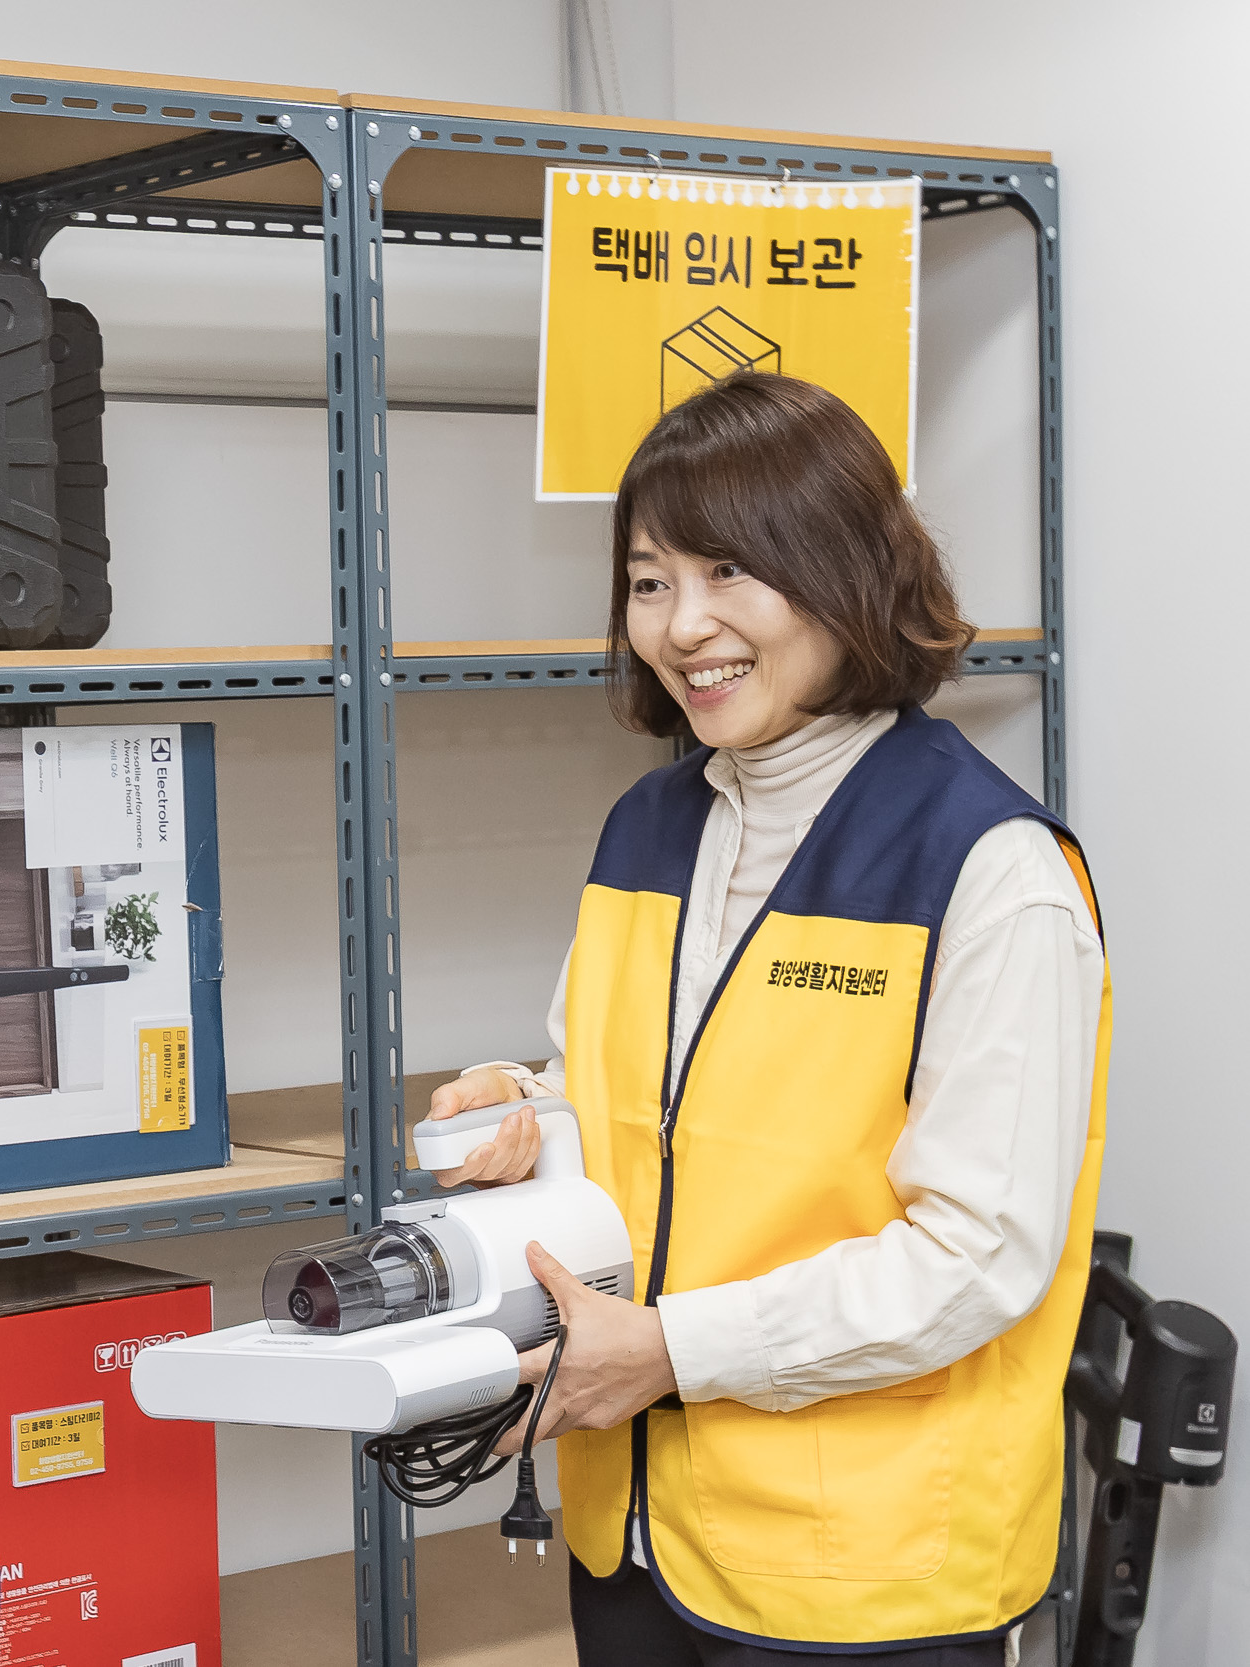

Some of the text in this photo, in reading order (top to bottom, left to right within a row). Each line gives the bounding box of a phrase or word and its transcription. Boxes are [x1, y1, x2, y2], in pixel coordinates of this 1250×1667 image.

[593, 226, 862, 289] 택배 임시 보관
[110, 739, 118, 778] Well Q6
[122, 738, 132, 775] Always
[124, 776, 132, 787] at
[133, 738, 143, 851] Versatile performance.
[156, 767, 170, 842] Electrolux
[767, 959, 889, 997] 화양생활지원센터
[31, 1436, 61, 1449] 대여기간
[67, 1432, 81, 1443] 3일
[0, 1562, 24, 1582] AN
